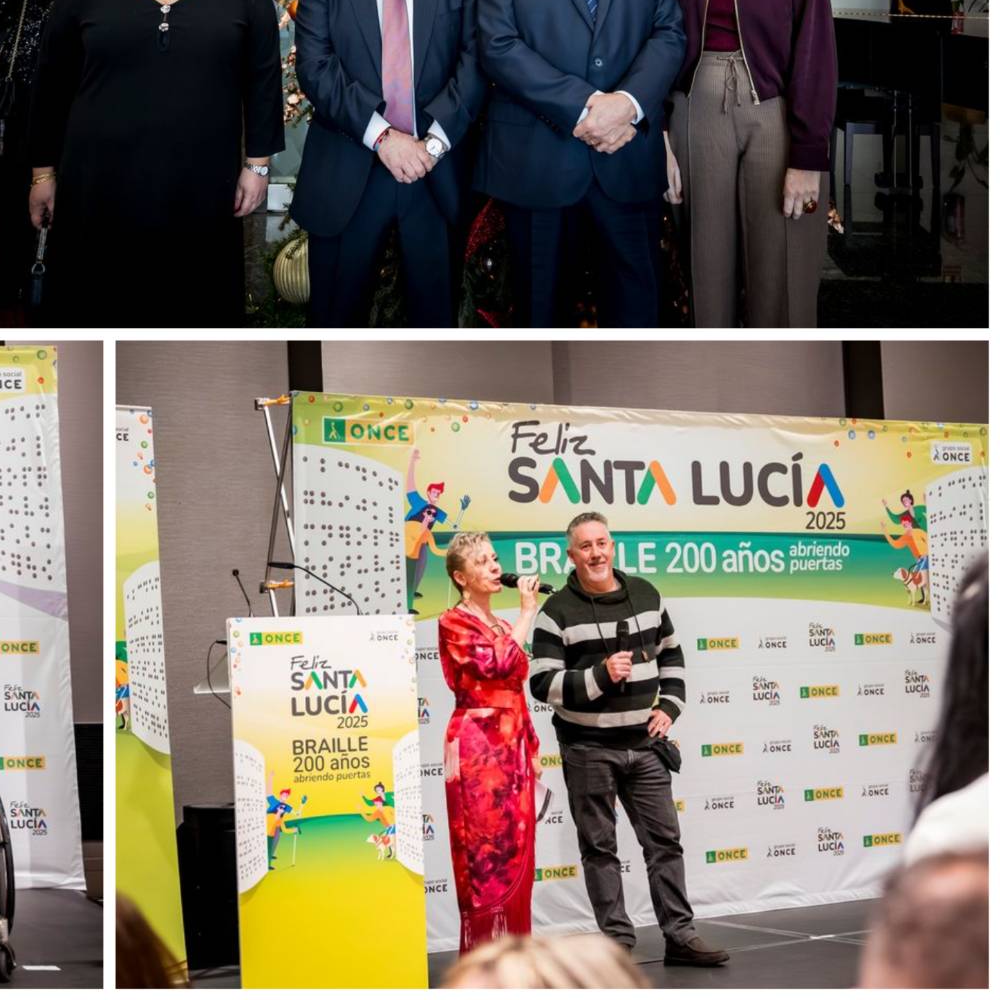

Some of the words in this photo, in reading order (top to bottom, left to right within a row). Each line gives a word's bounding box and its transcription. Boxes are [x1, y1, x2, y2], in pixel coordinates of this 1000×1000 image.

[350, 423, 410, 441] ONCE
[511, 420, 595, 455] Feliz
[942, 452, 970, 462] ONCE
[508, 456, 677, 506] SANTA
[691, 452, 845, 508] LUCÍA
[805, 511, 846, 530] 2025
[789, 541, 850, 557] abriendo
[665, 541, 717, 573] 200
[722, 541, 785, 573] años
[789, 557, 843, 574] puertas
[265, 632, 300, 643] ONCE
[865, 634, 892, 644] ONCE
[1, 643, 38, 652] ONCE
[709, 639, 738, 648] ONCE
[765, 641, 787, 649] ONCE
[290, 655, 331, 671] Feliz
[291, 669, 367, 691] SANTA
[4, 691, 40, 700] SANTA
[809, 686, 838, 696] ONCE
[863, 687, 885, 696] ONCE
[291, 690, 368, 716] LUCÍA
[707, 694, 730, 703] ONCE
[4, 700, 40, 712] LUCÍA
[534, 704, 552, 712] ONC
[337, 715, 368, 729] 2025
[869, 734, 896, 744] ONCE
[292, 736, 368, 755] BRAILLE
[714, 744, 741, 754] ONCE
[769, 744, 791, 752] ONCE
[6, 758, 43, 769] ONCE
[293, 755, 325, 773] 200
[330, 752, 370, 769] años
[293, 773, 334, 784] abriendo
[336, 771, 371, 782] puertas
[815, 788, 842, 799] ONCE
[867, 787, 889, 796] ONCE
[711, 801, 734, 809] ONCE
[10, 808, 46, 817] SANTA
[10, 816, 47, 829] LUCÍA
[872, 834, 901, 844] ONCE
[717, 849, 746, 861] ONCE
[774, 847, 796, 856] ONCE
[545, 866, 576, 878] ONCE
